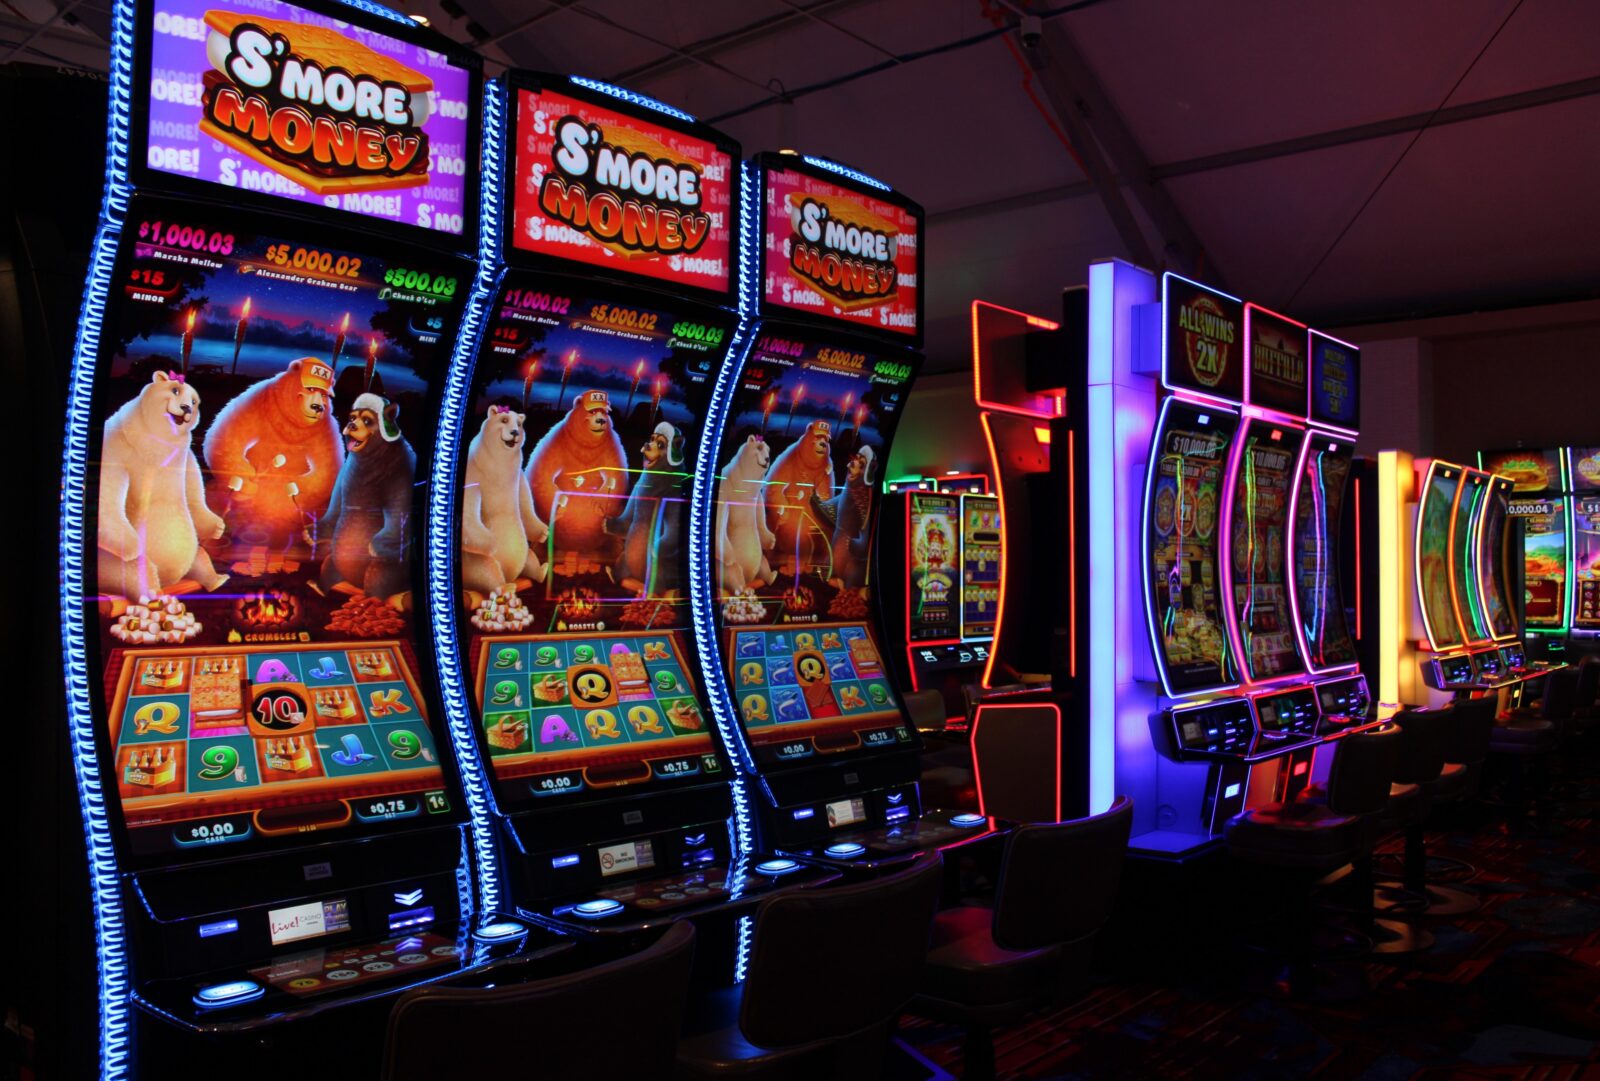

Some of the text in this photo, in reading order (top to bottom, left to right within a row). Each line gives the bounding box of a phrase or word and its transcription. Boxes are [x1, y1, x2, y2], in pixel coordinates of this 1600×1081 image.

[230, 30, 409, 125] S'MORE
[213, 88, 419, 171] MONEY
[557, 122, 698, 206] S'MORE
[543, 178, 708, 250] MONEY
[139, 221, 235, 255] $1,000.03
[801, 202, 888, 261] S'MORE
[154, 251, 223, 269] Marsha Mellow
[265, 244, 362, 278] $5,000.02
[793, 245, 894, 295] MONEY
[131, 270, 165, 285] $15
[384, 268, 458, 296] $500.03
[132, 292, 164, 304] MINOR
[590, 305, 658, 331] $5,000.02
[244, 631, 297, 642] CRUMBLES
[577, 673, 608, 699] Q
[257, 696, 299, 724] 10
[663, 761, 689, 772] $0.75
[541, 777, 570, 789] $0.00
[370, 800, 405, 814] $0.75
[191, 822, 234, 838] $0.00
